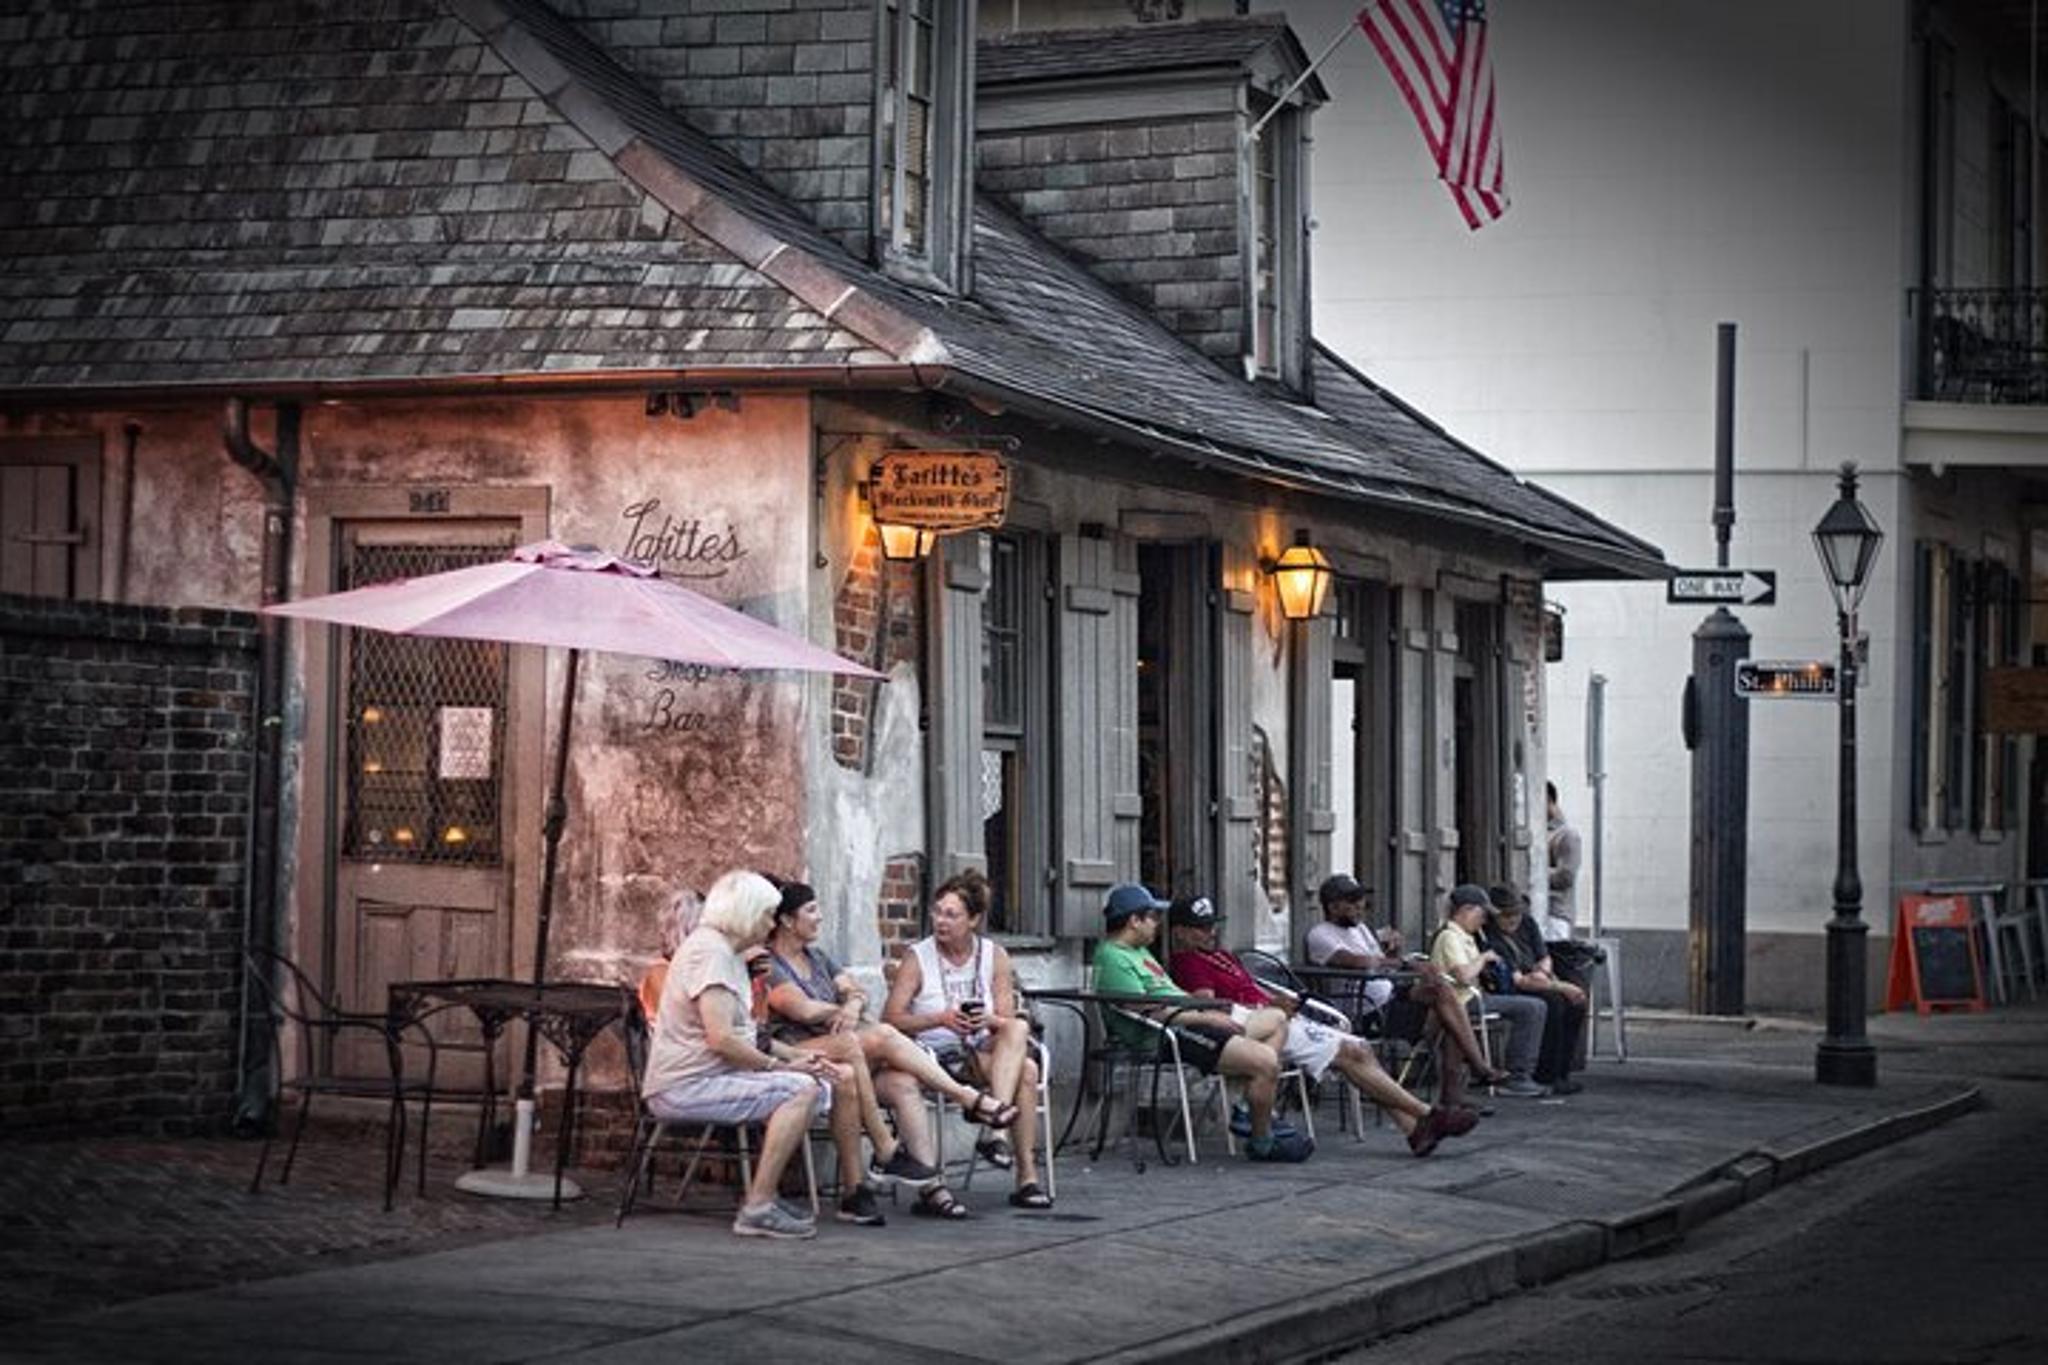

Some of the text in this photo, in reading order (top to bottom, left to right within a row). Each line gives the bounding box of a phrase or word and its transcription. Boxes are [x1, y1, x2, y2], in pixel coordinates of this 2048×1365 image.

[1678, 579, 1743, 594] ONE WAY
[642, 688, 707, 731] Bar
